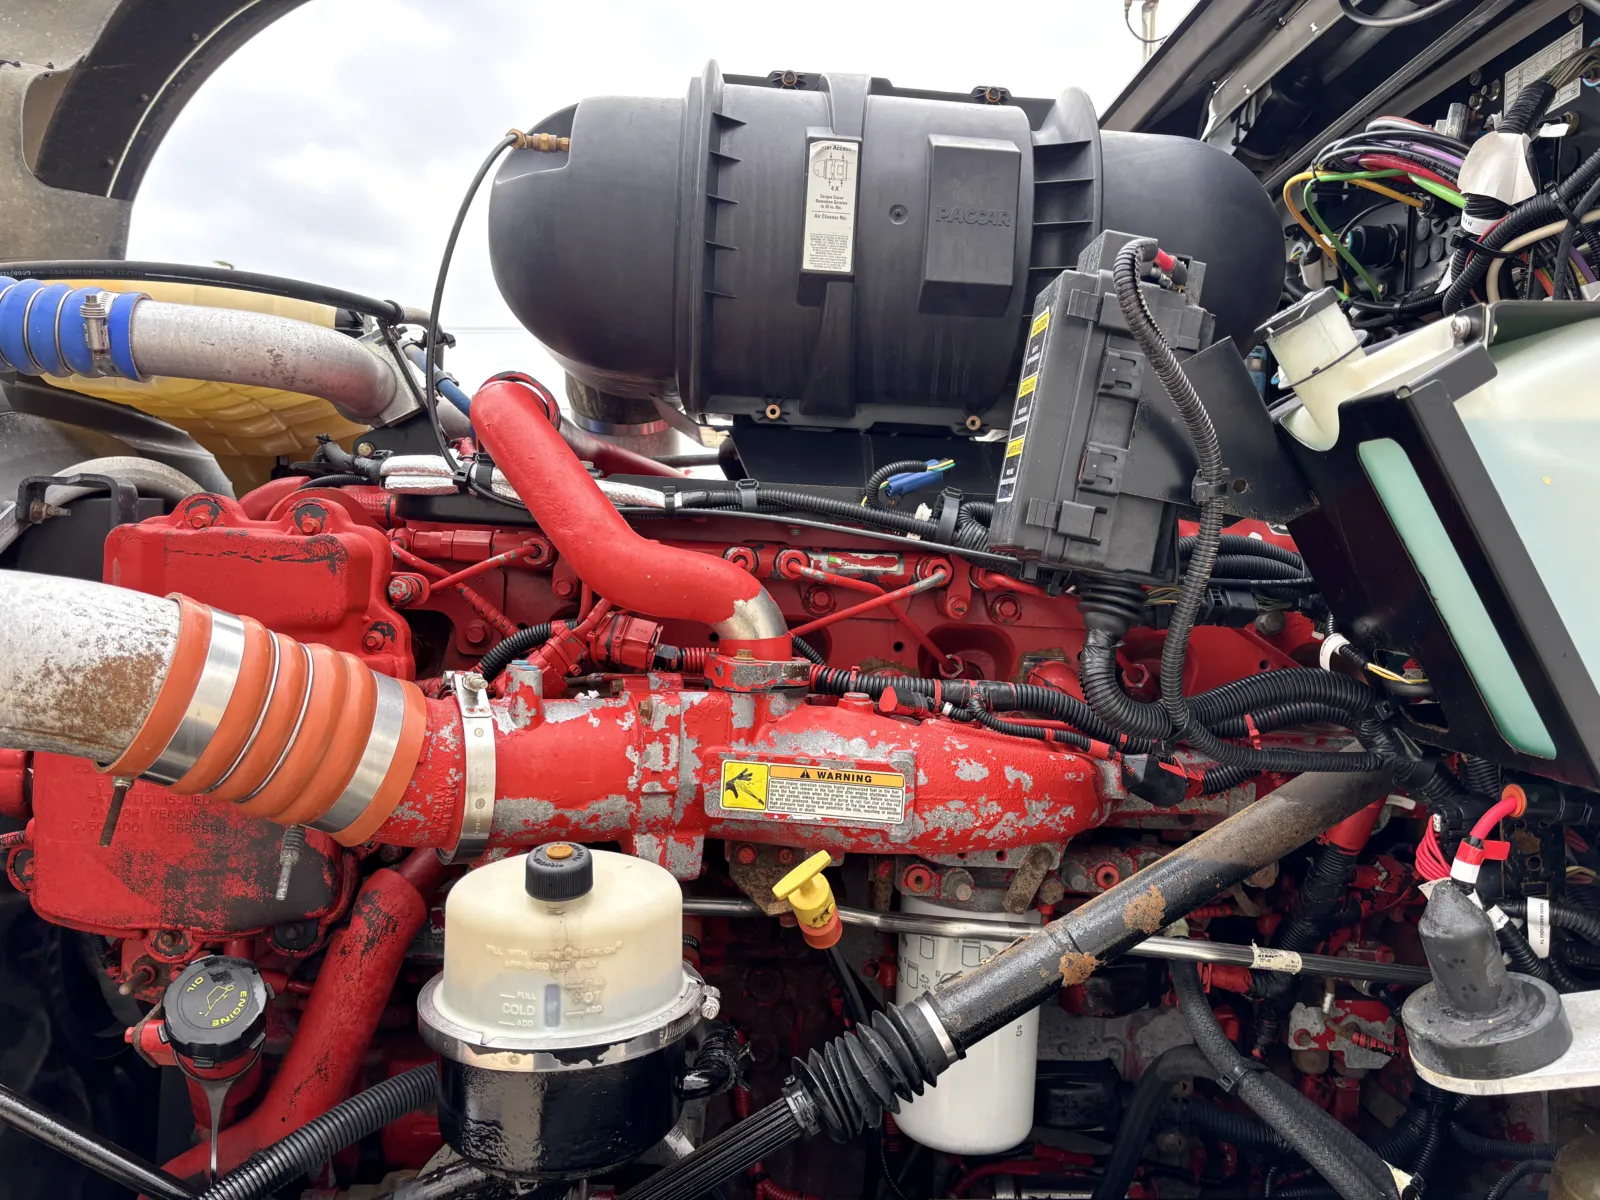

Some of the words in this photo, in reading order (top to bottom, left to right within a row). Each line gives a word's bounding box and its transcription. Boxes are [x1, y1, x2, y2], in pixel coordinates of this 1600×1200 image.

[936, 206, 1011, 227] PACCAR
[817, 771, 872, 783] WARNING
[187, 976, 204, 993] OIL
[517, 991, 537, 1000] FULL
[211, 990, 248, 1028] ENGINE
[502, 1002, 536, 1016] COLD
[516, 1019, 534, 1028] ADD
